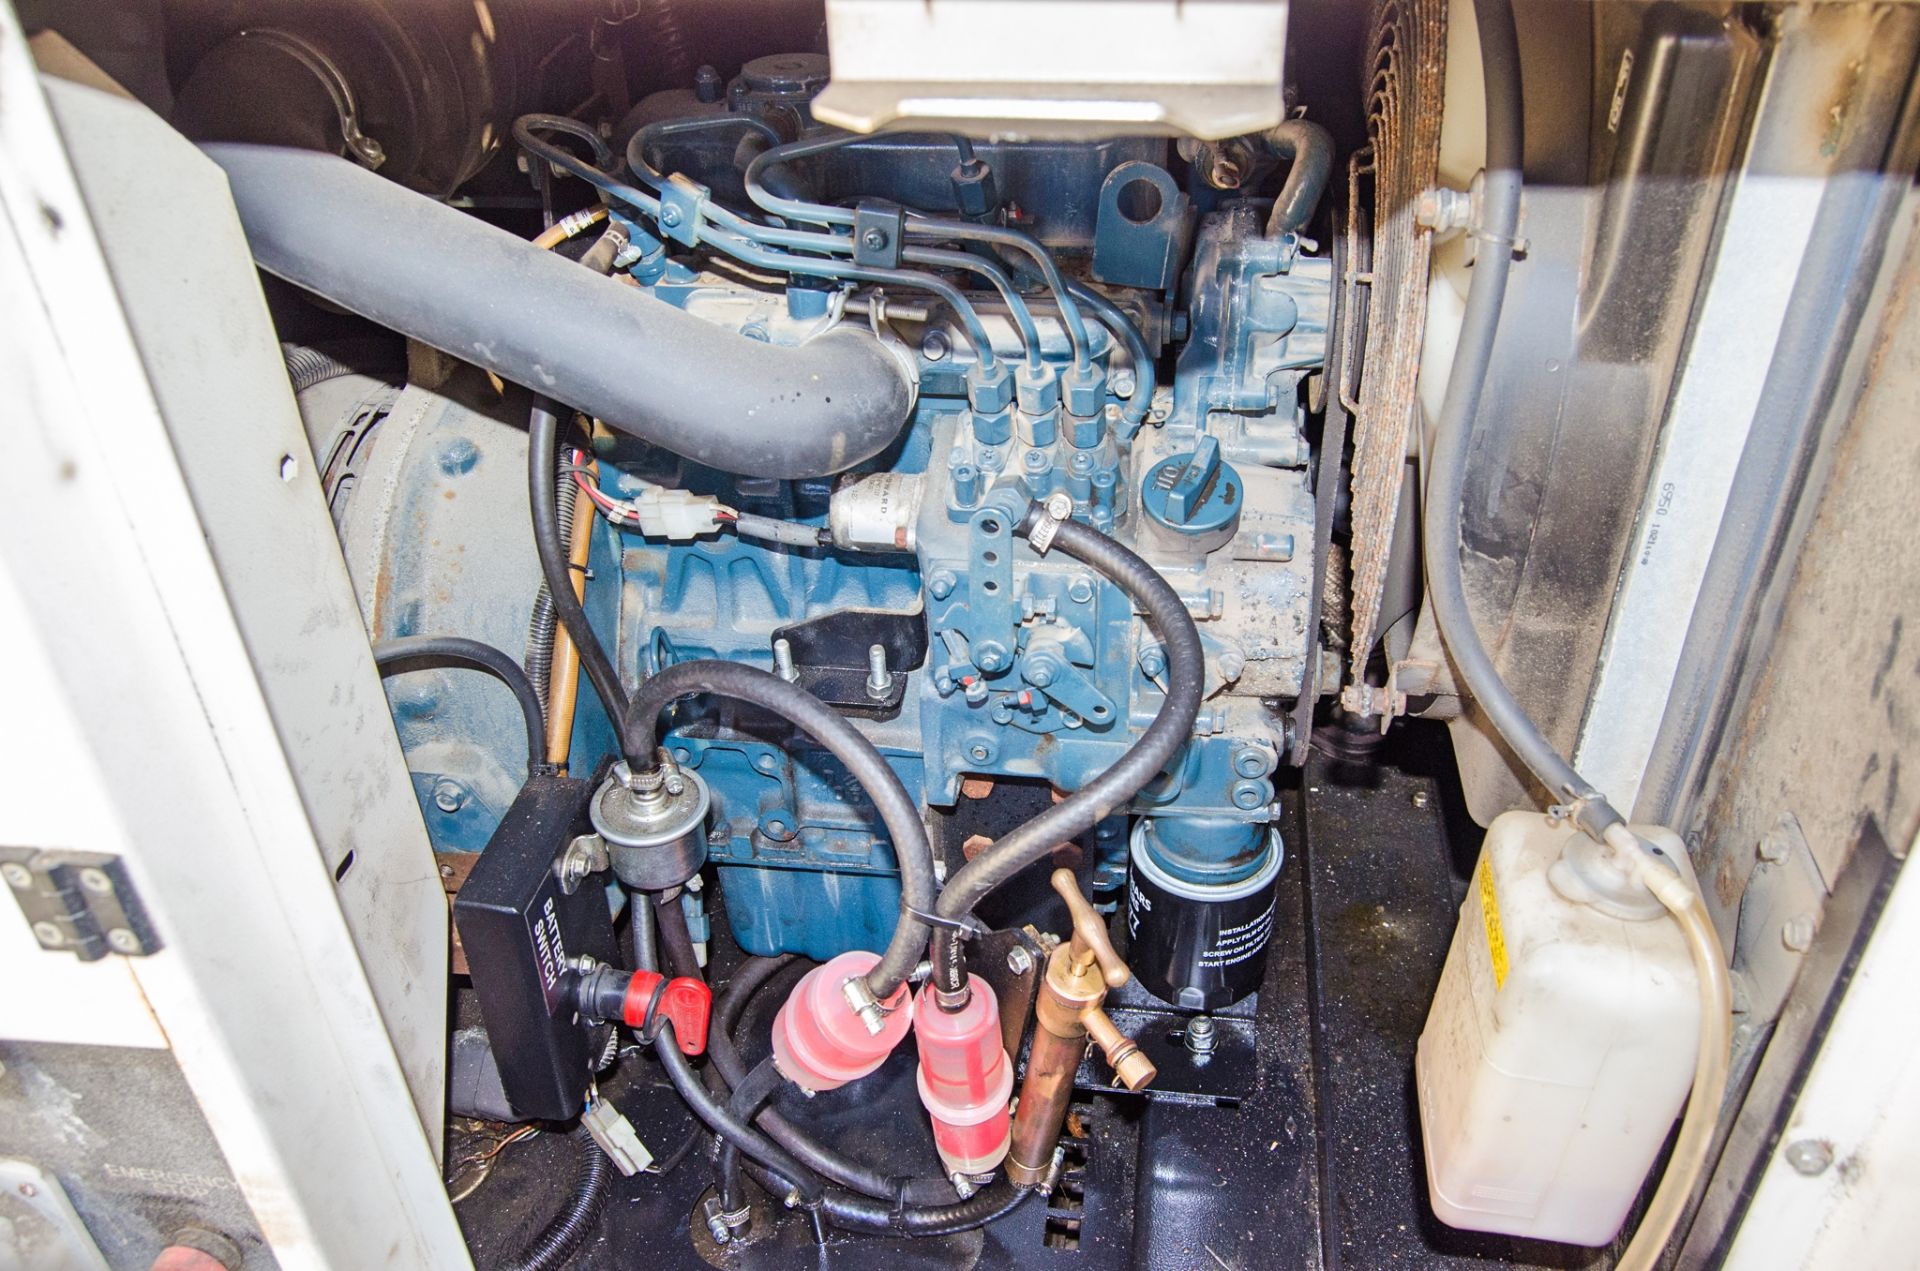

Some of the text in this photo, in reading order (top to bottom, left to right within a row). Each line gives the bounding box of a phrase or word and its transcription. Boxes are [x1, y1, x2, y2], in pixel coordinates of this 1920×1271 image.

[1151, 464, 1181, 491] OIL
[543, 896, 569, 977] BATTERY
[1216, 937, 1241, 947] APPLY
[1241, 928, 1257, 941] FILM
[1219, 912, 1267, 937] INSTALLATION
[534, 918, 557, 991] SWITCH
[1203, 949, 1233, 958] SCREW
[1233, 945, 1245, 954] ON
[1245, 932, 1265, 950] FILTER
[1198, 960, 1224, 968] START
[1225, 951, 1252, 966] ENGINE
[103, 1162, 239, 1190] EMERGENCY
